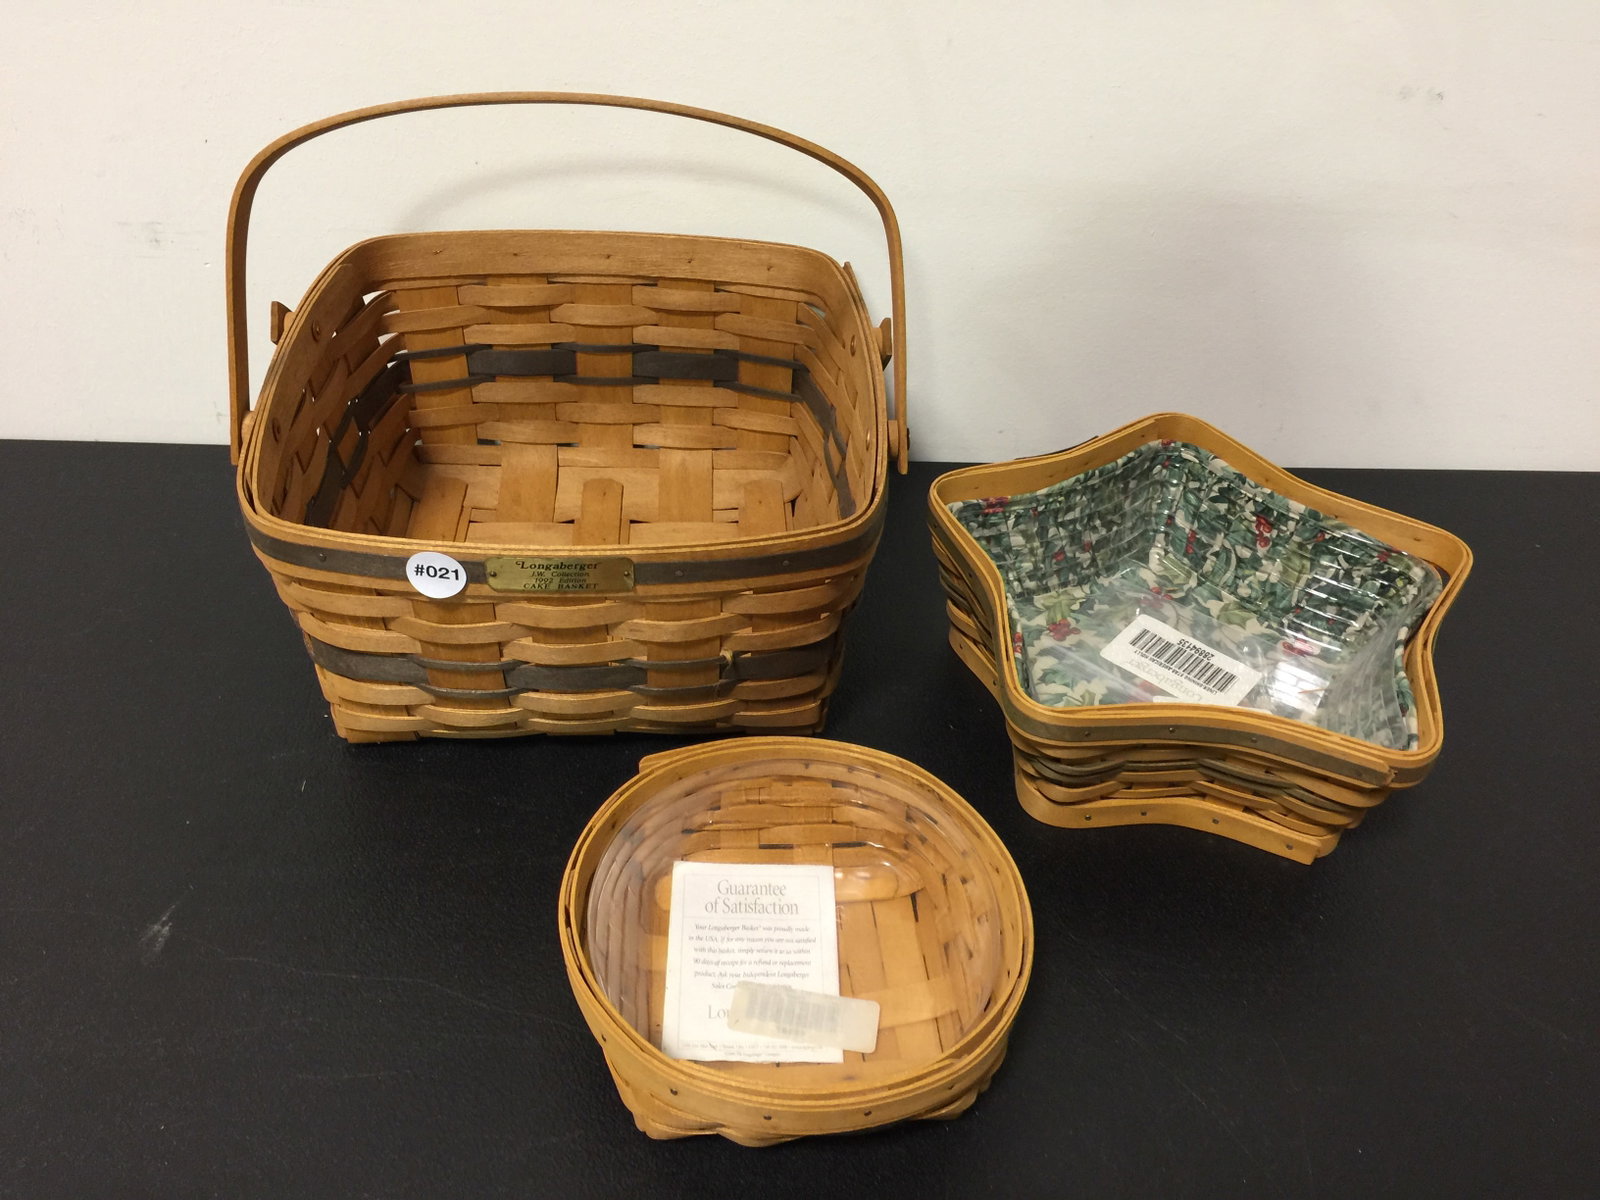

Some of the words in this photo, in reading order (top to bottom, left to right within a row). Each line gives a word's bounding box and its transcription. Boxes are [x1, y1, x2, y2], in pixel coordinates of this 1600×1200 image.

[413, 563, 460, 581] #021
[515, 560, 602, 571] Longaberger
[551, 570, 591, 578] Collection
[1176, 637, 1215, 662] 28894135
[717, 879, 788, 896] Guarantee
[704, 895, 721, 914] of
[722, 896, 799, 915] Satisfaction
[779, 960, 811, 968] replacement
